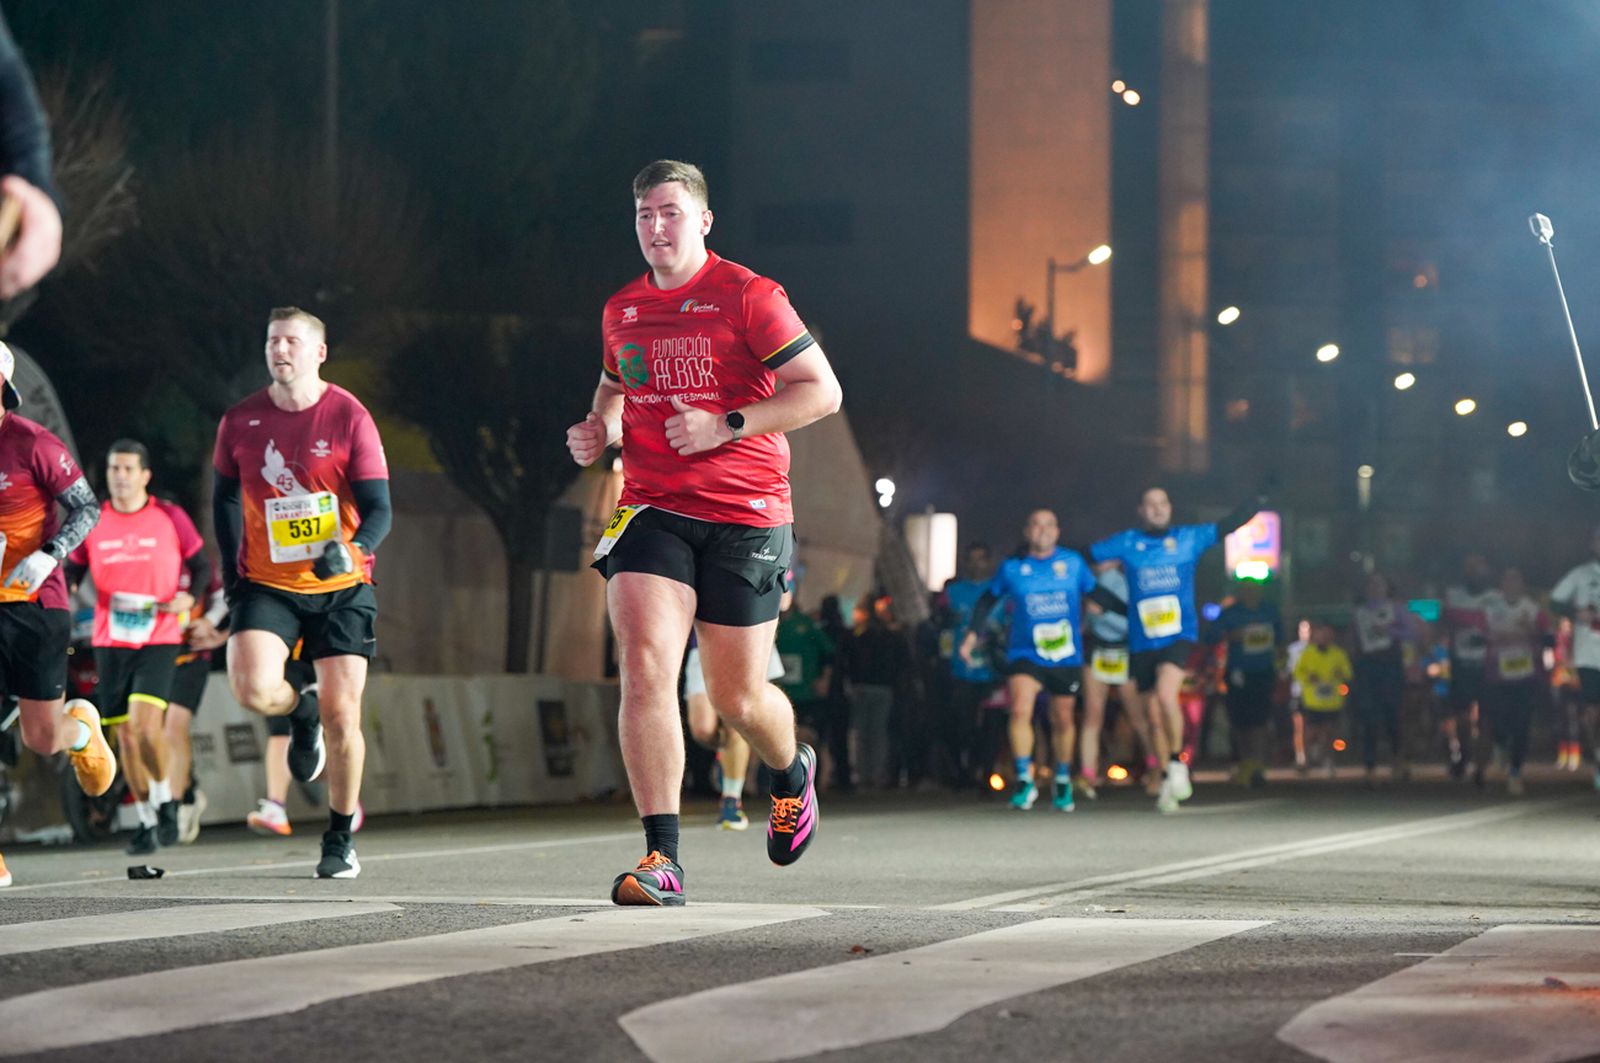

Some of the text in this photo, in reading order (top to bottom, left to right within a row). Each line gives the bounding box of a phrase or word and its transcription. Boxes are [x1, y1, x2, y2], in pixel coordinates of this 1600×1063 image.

[651, 332, 711, 358] FUNDACIÓN
[653, 357, 719, 391] ALBOR
[276, 474, 294, 492] 43
[289, 518, 320, 539] 537
